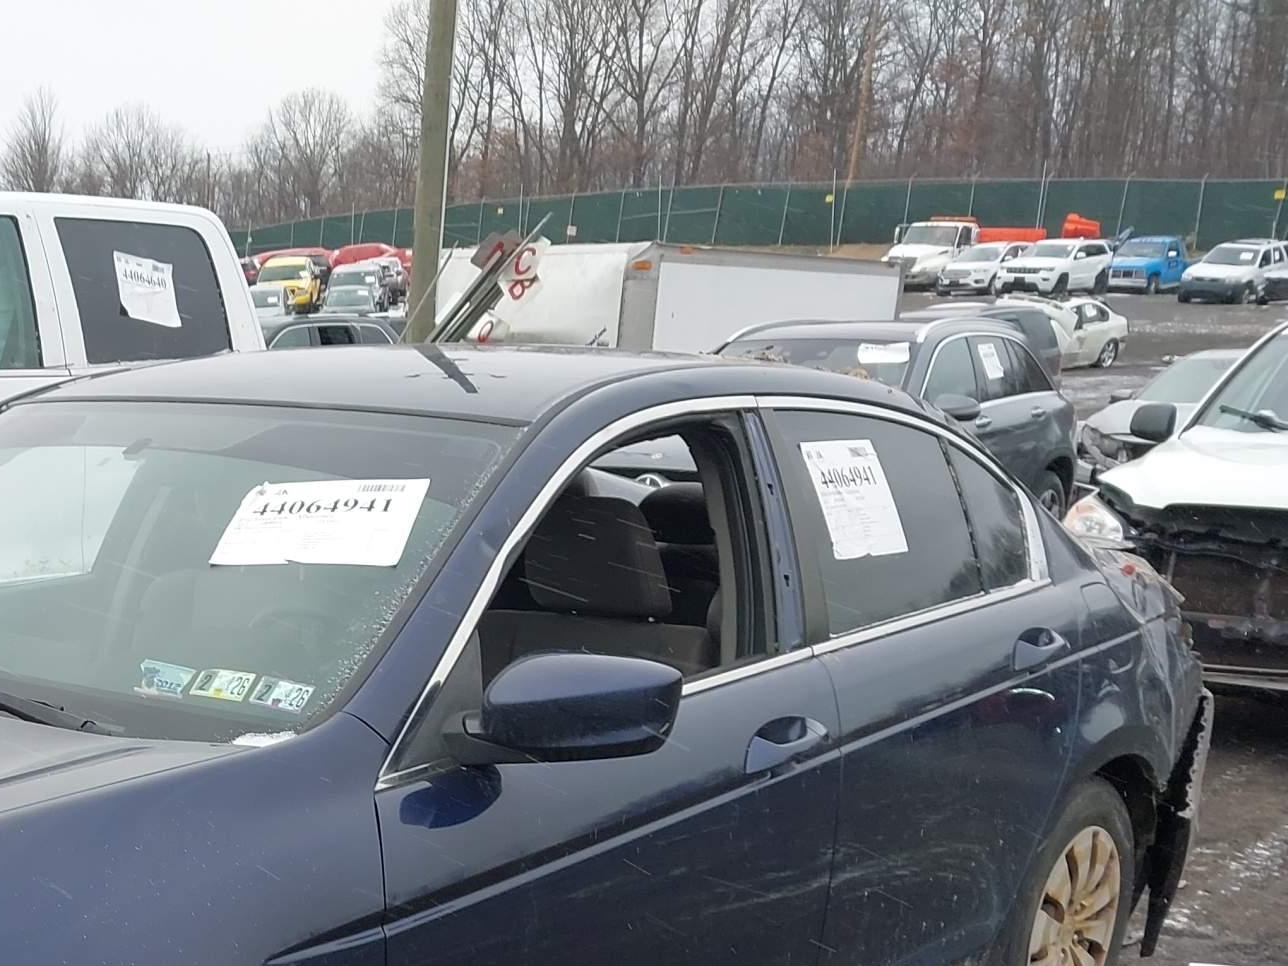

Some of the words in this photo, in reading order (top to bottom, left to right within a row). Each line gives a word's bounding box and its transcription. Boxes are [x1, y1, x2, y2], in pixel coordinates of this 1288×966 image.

[820, 465, 877, 488] 44064941
[253, 498, 393, 516] 44064941
[230, 676, 249, 696] 26
[289, 687, 309, 707] 26
